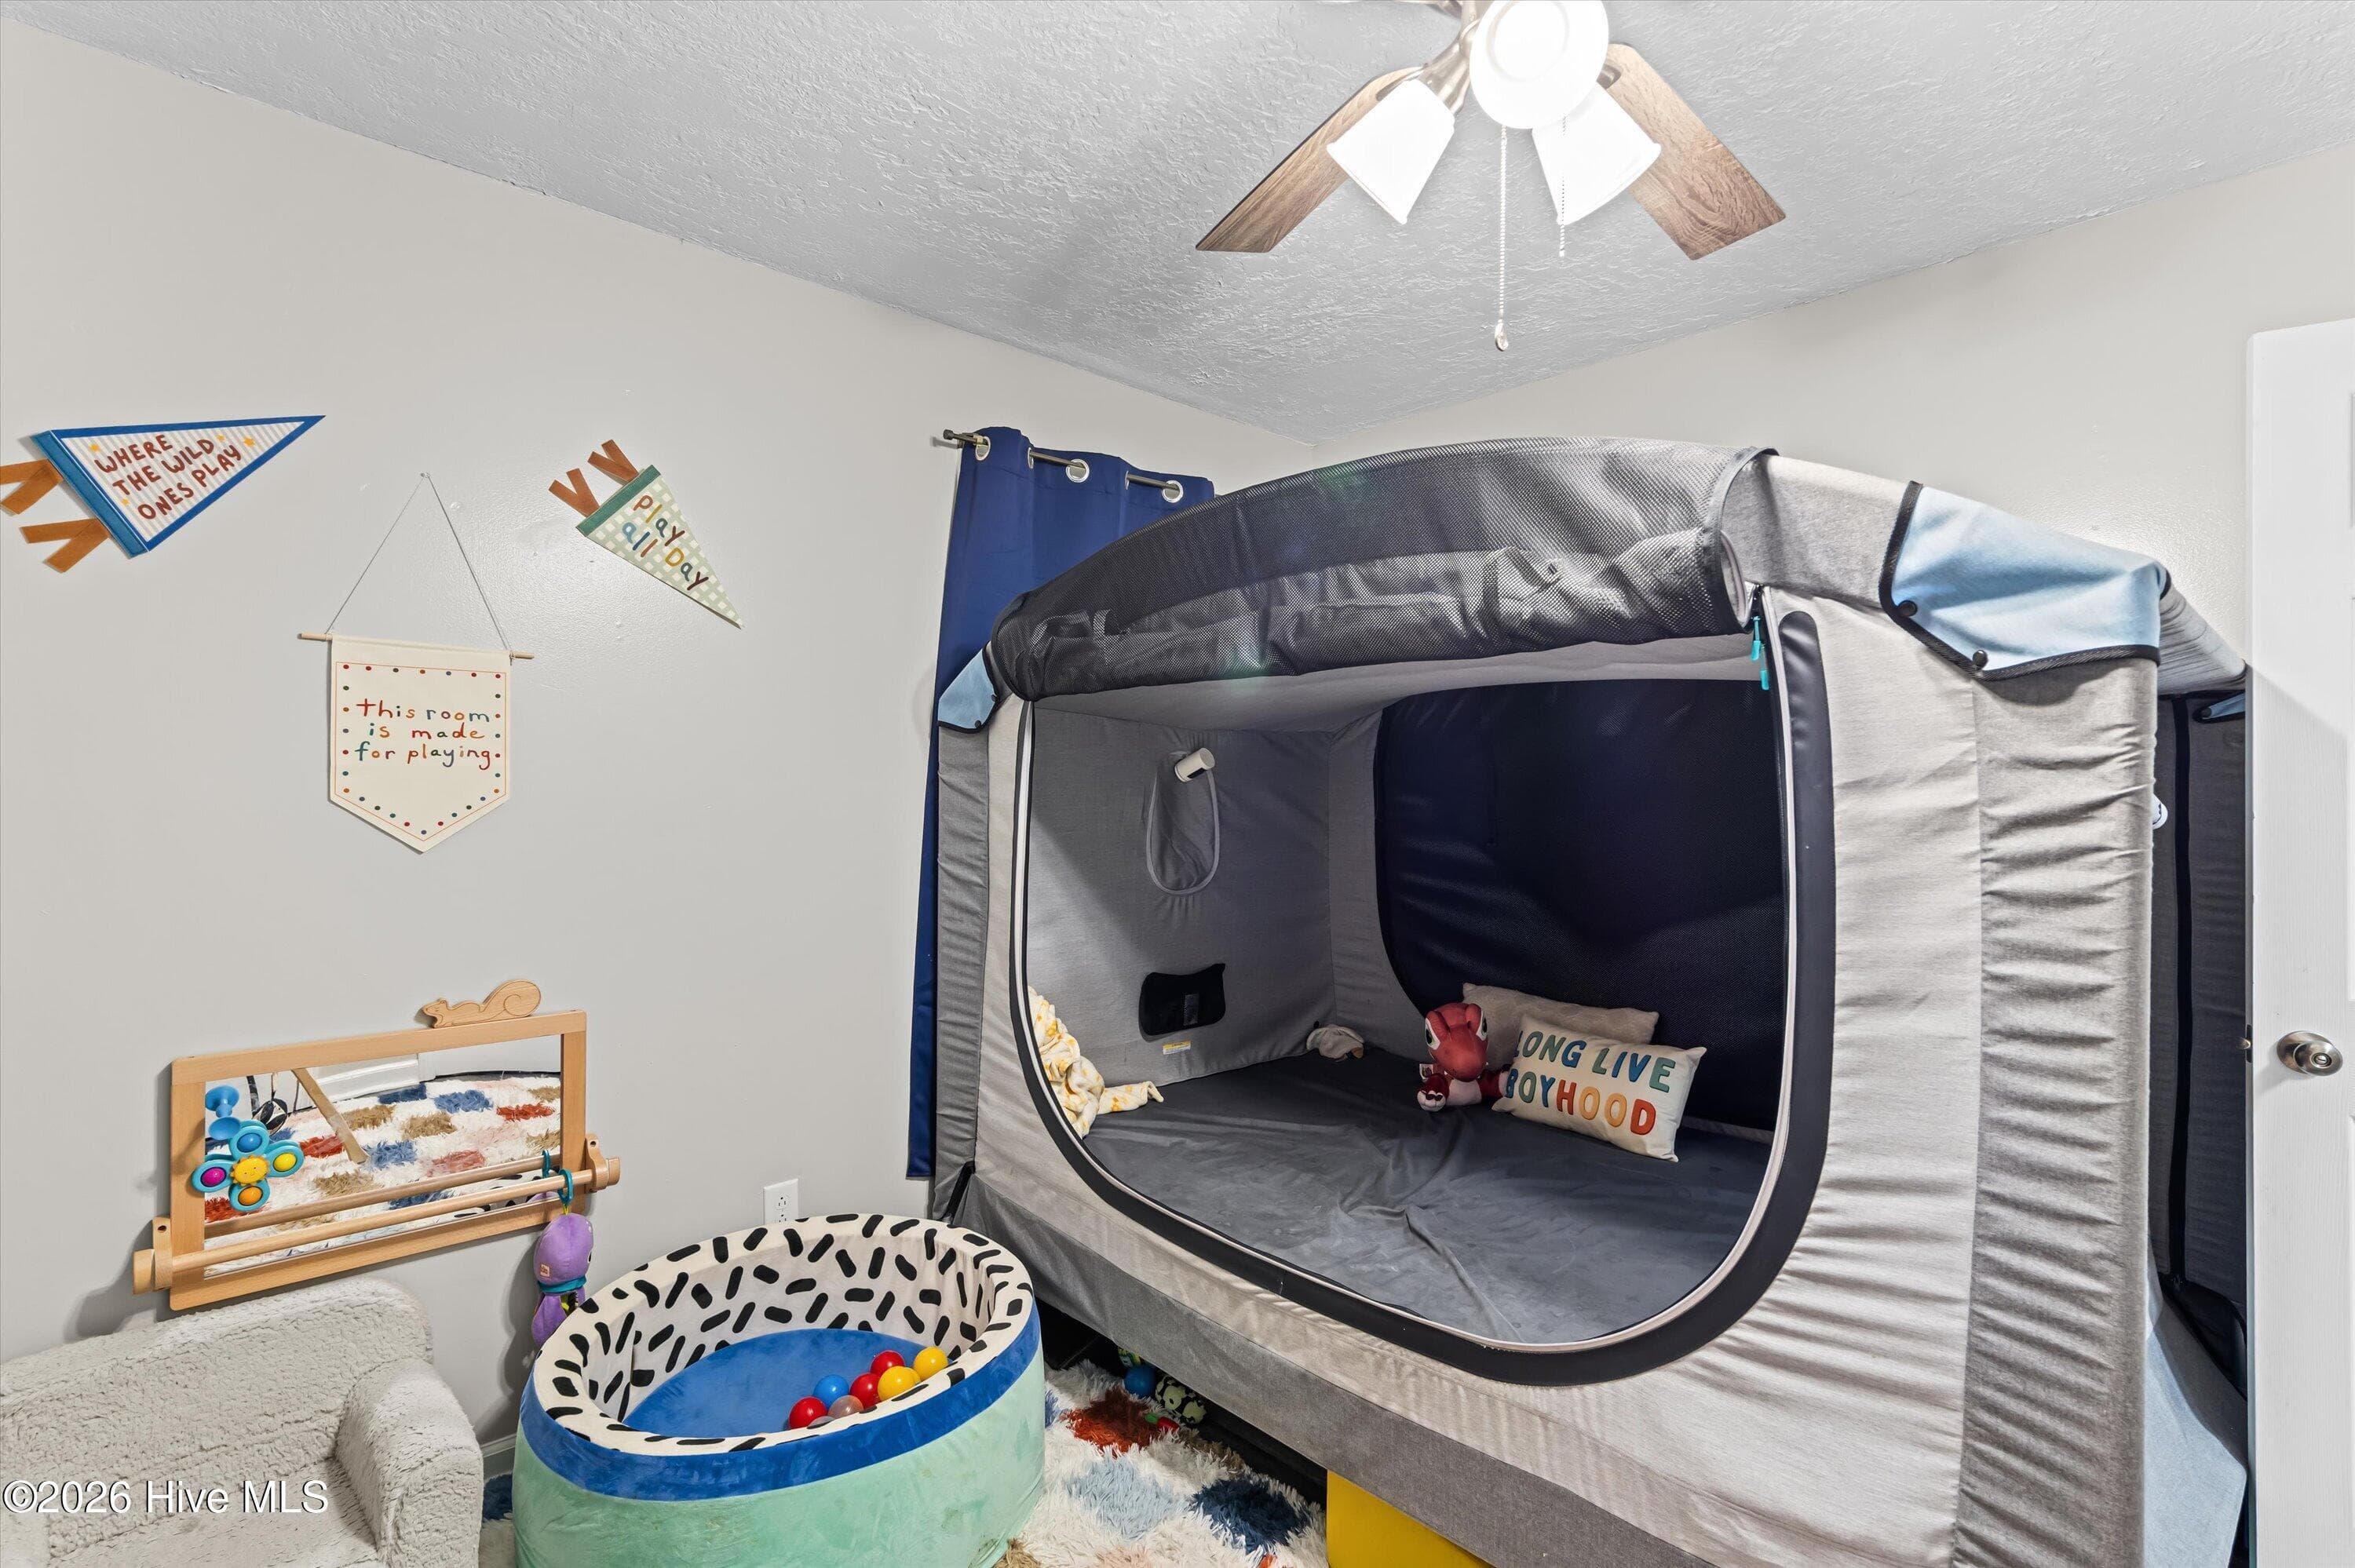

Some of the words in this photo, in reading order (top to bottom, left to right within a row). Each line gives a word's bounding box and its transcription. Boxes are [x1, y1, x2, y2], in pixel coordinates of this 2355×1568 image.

[94, 434, 173, 472] WHERE
[112, 465, 161, 496] THE
[161, 438, 214, 474] WILD
[137, 482, 194, 520] ONES
[191, 445, 242, 487] PLAY
[356, 698, 415, 718] this
[426, 709, 490, 722] room
[369, 723, 390, 738] is
[411, 722, 485, 739] made
[354, 741, 396, 761] for
[407, 743, 491, 771] playing
[1592, 1047, 1677, 1094] LIVE
[1503, 1068, 1656, 1136] BOYHOOD
